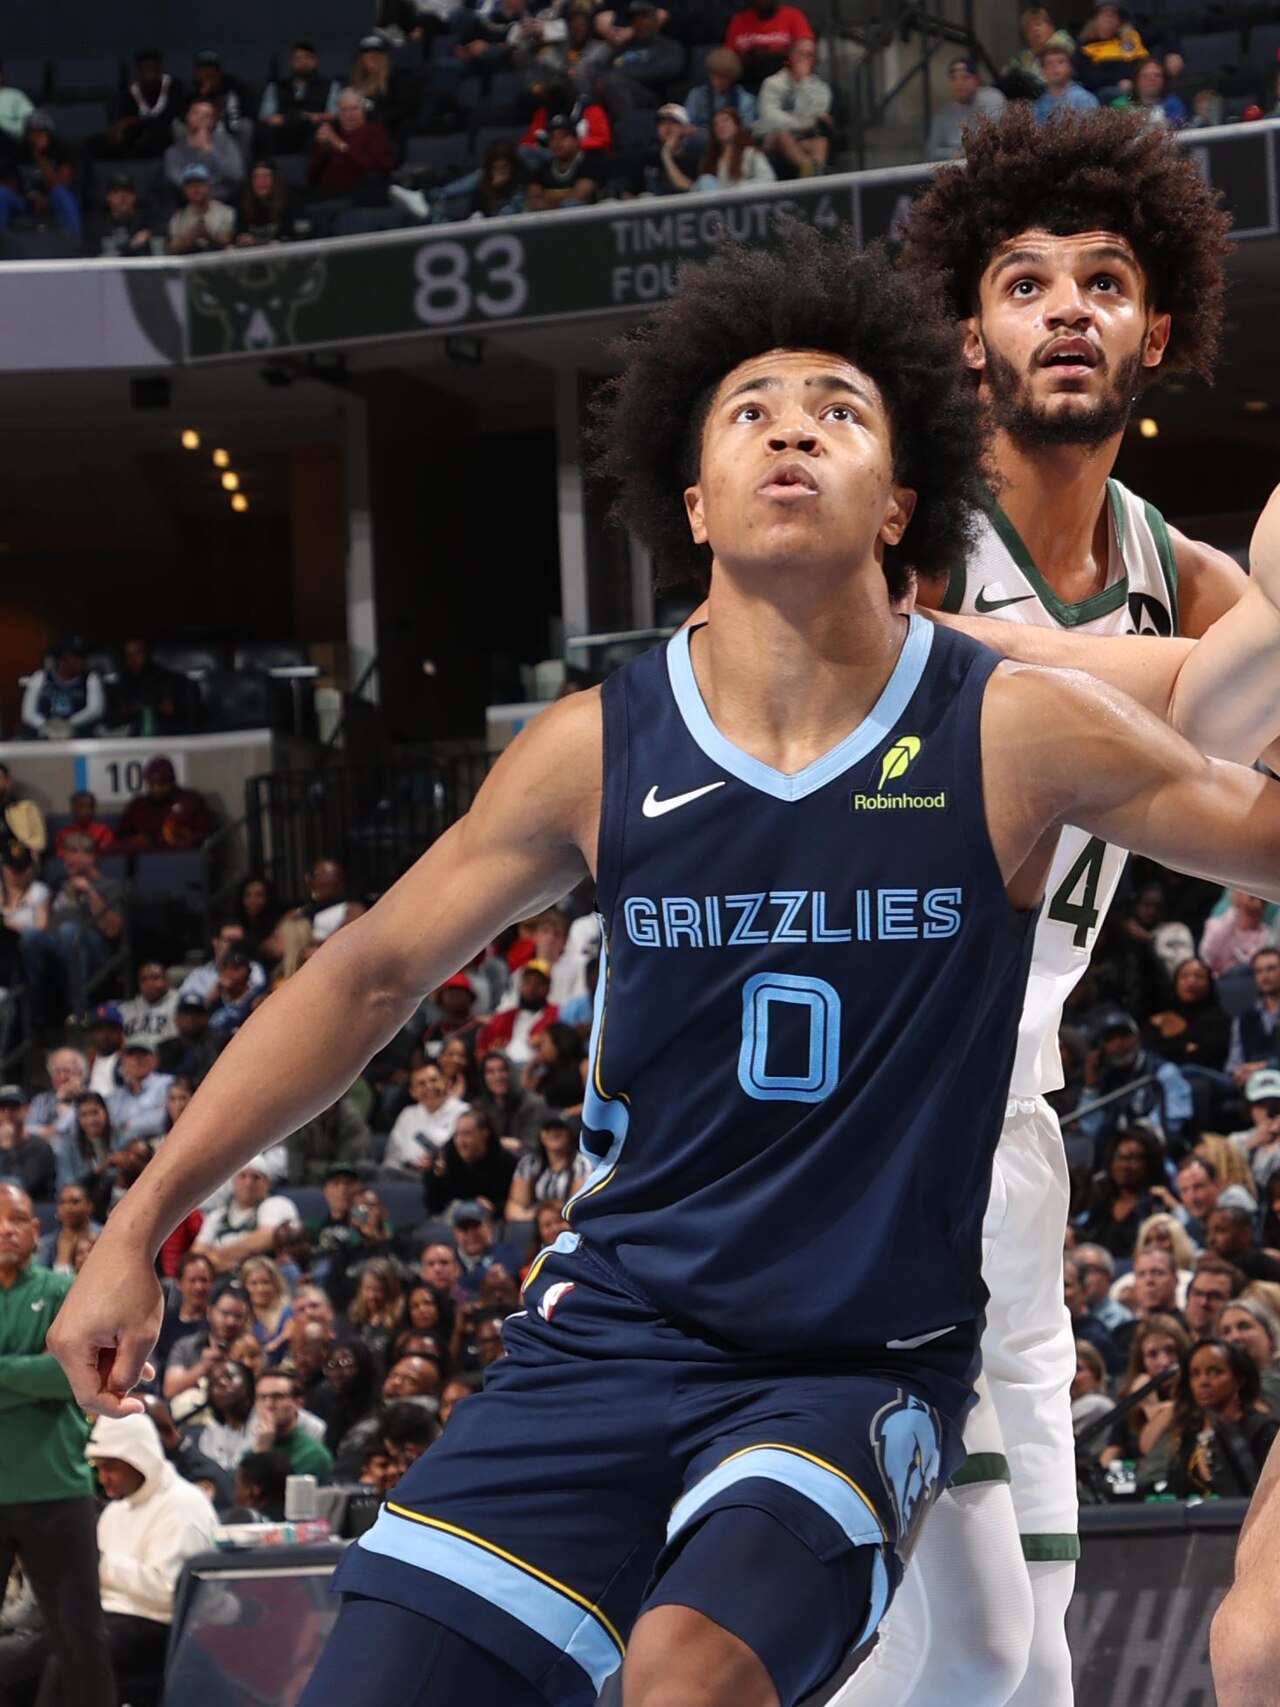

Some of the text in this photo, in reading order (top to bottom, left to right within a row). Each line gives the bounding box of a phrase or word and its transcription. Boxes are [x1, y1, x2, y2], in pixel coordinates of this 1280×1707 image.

[413, 233, 529, 325] 83
[612, 262, 682, 300] FOU
[105, 761, 143, 793] 10
[854, 792, 945, 810] Robinhood
[624, 887, 962, 948] GRIZZLIES
[738, 972, 841, 1103] 0
